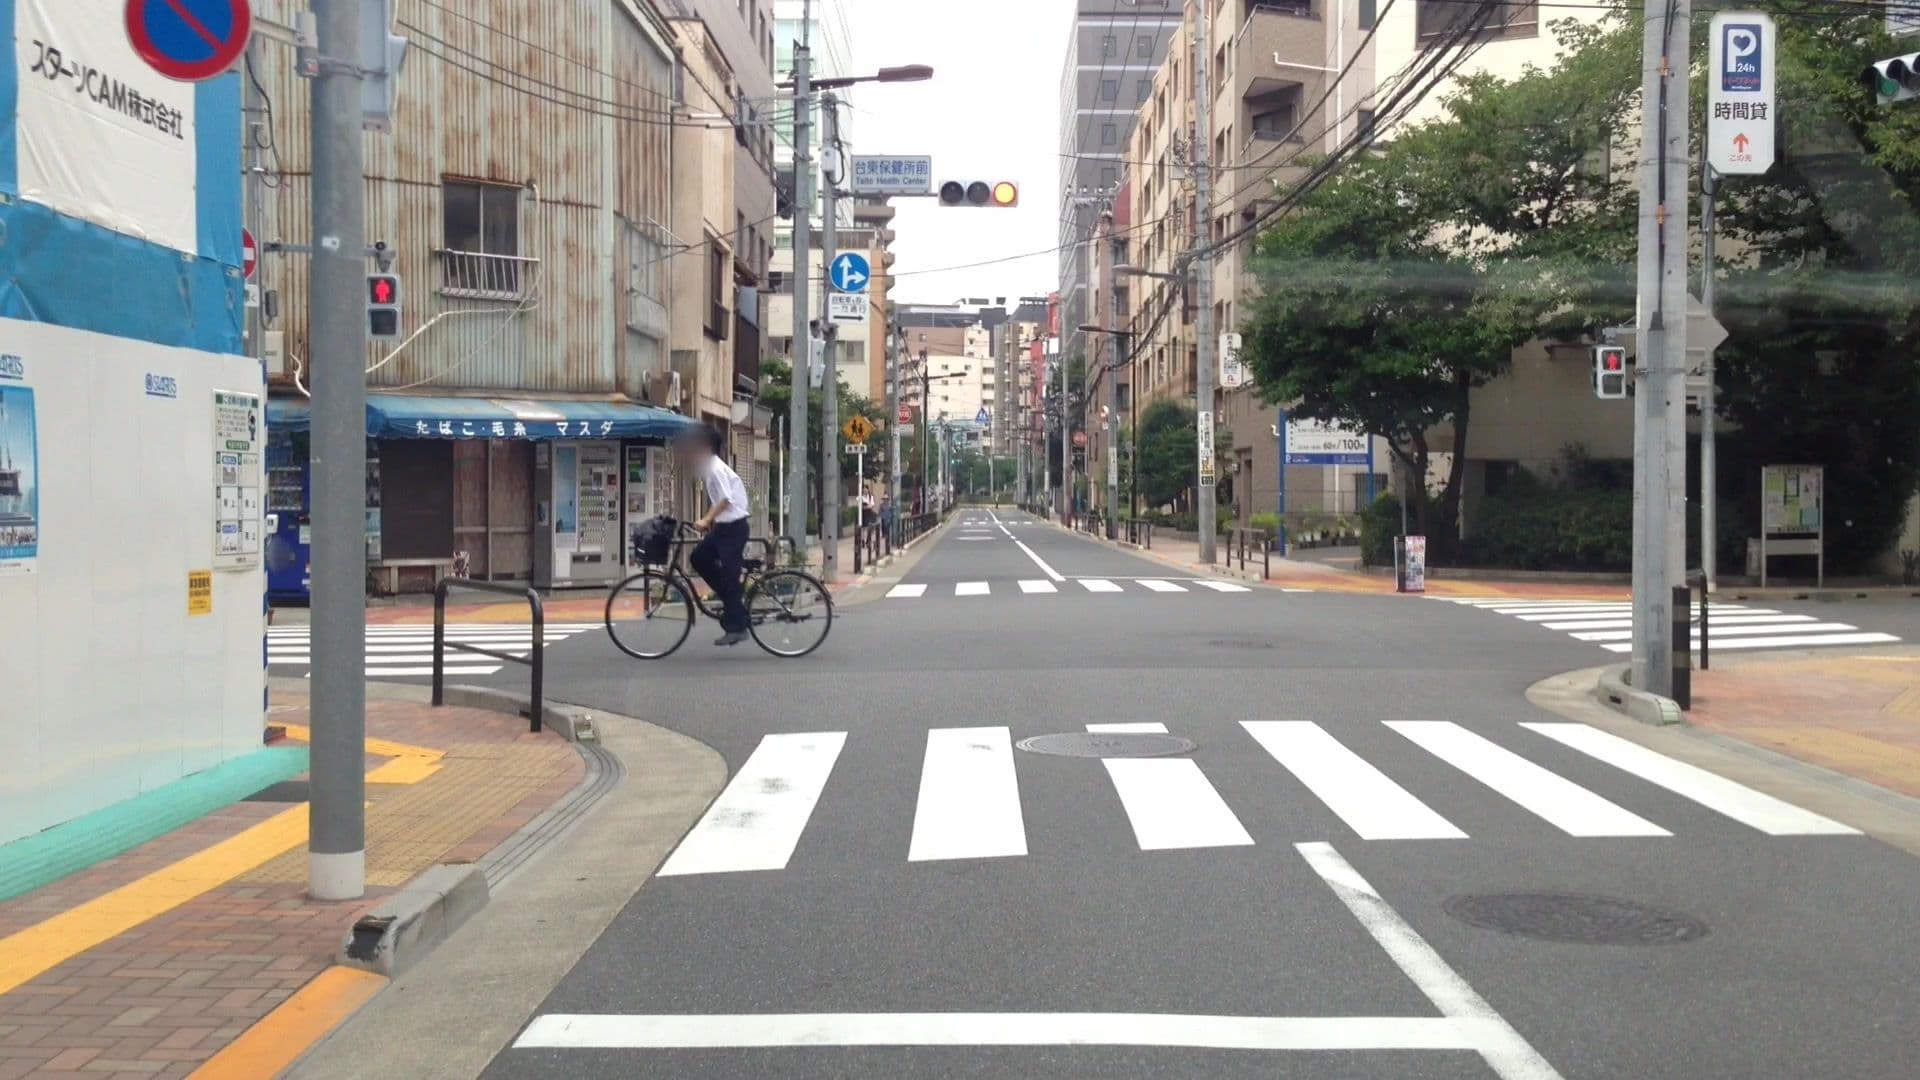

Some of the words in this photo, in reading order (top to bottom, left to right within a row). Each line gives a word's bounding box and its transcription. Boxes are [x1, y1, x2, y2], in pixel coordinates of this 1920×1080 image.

[1737, 63, 1756, 73] 24h
[31, 39, 184, 140] スターツCAM株式会社
[1714, 102, 1768, 120] 時間貸
[855, 160, 928, 175] 台東保健所前
[556, 421, 614, 436] マスダ
